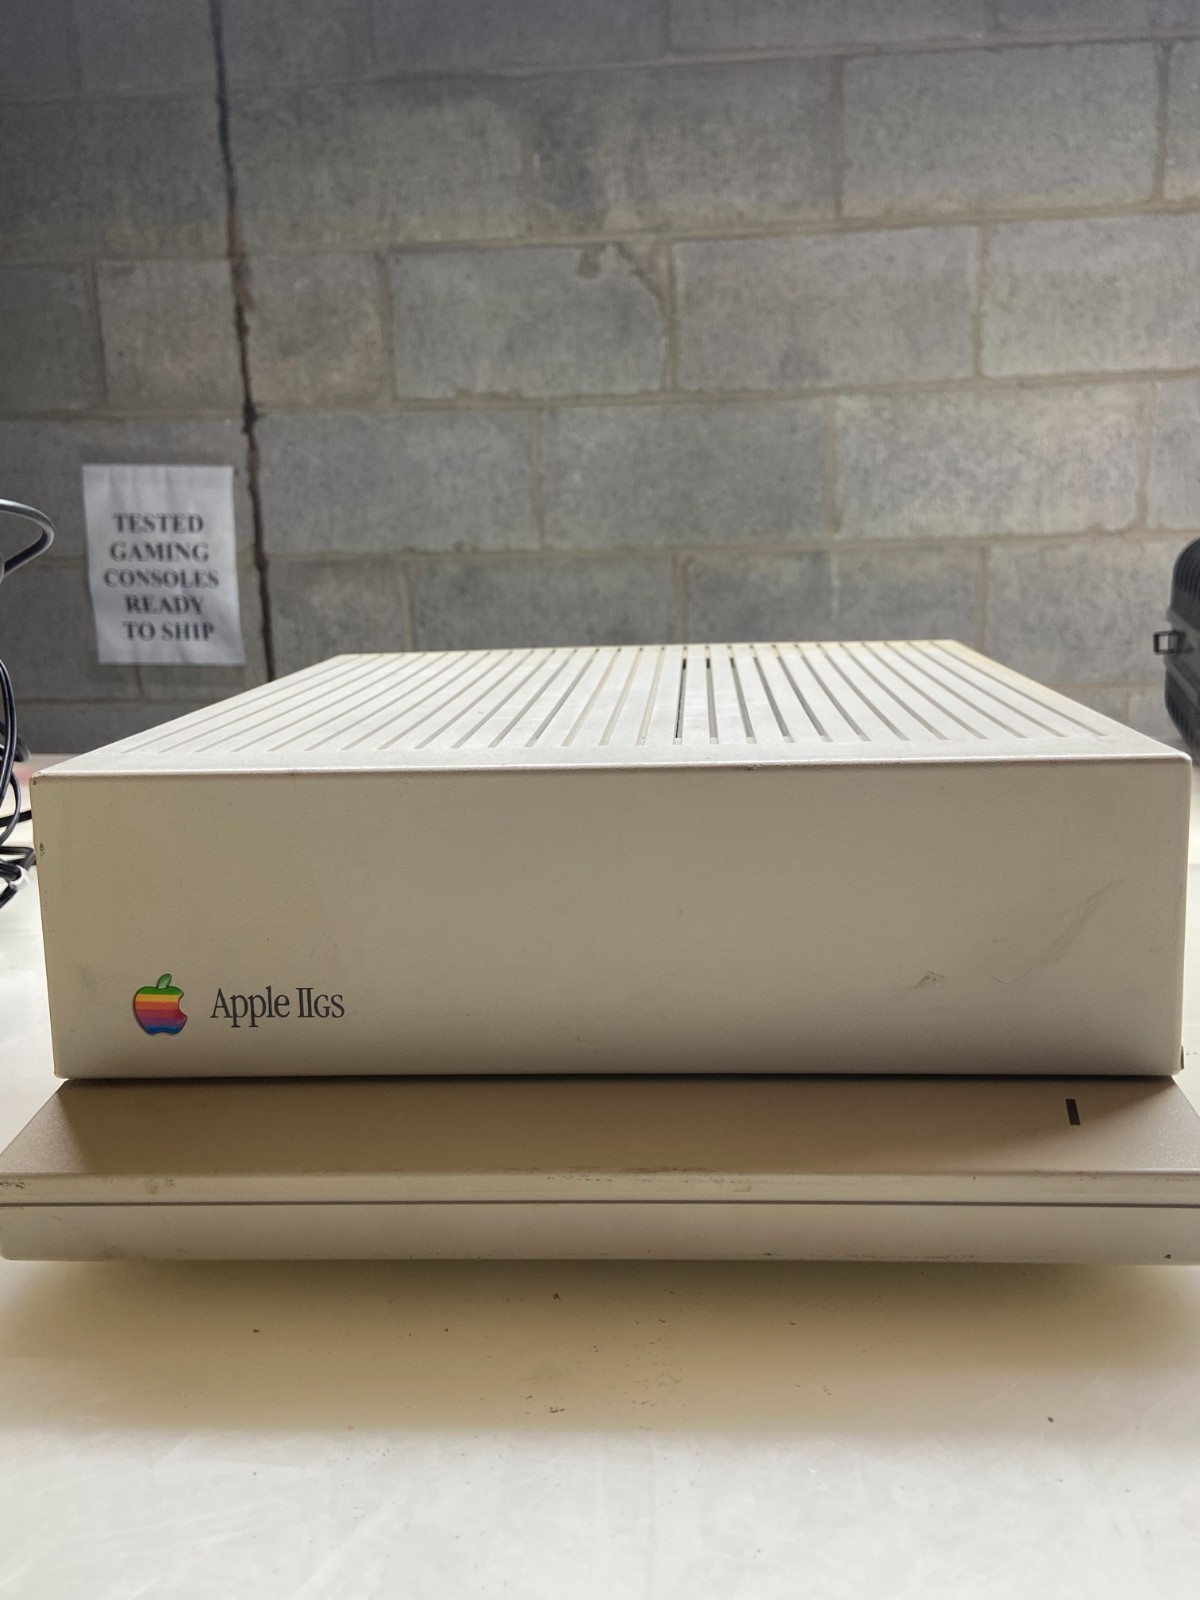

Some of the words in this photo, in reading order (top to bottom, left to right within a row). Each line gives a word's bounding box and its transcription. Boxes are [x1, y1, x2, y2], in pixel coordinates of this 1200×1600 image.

[113, 512, 204, 534] TESTED
[109, 541, 210, 563] GAMING
[103, 568, 220, 589] CONSOLES
[124, 594, 205, 615] READY
[122, 621, 156, 641] TO
[160, 621, 215, 641] SHIP
[210, 985, 291, 1028] Apple
